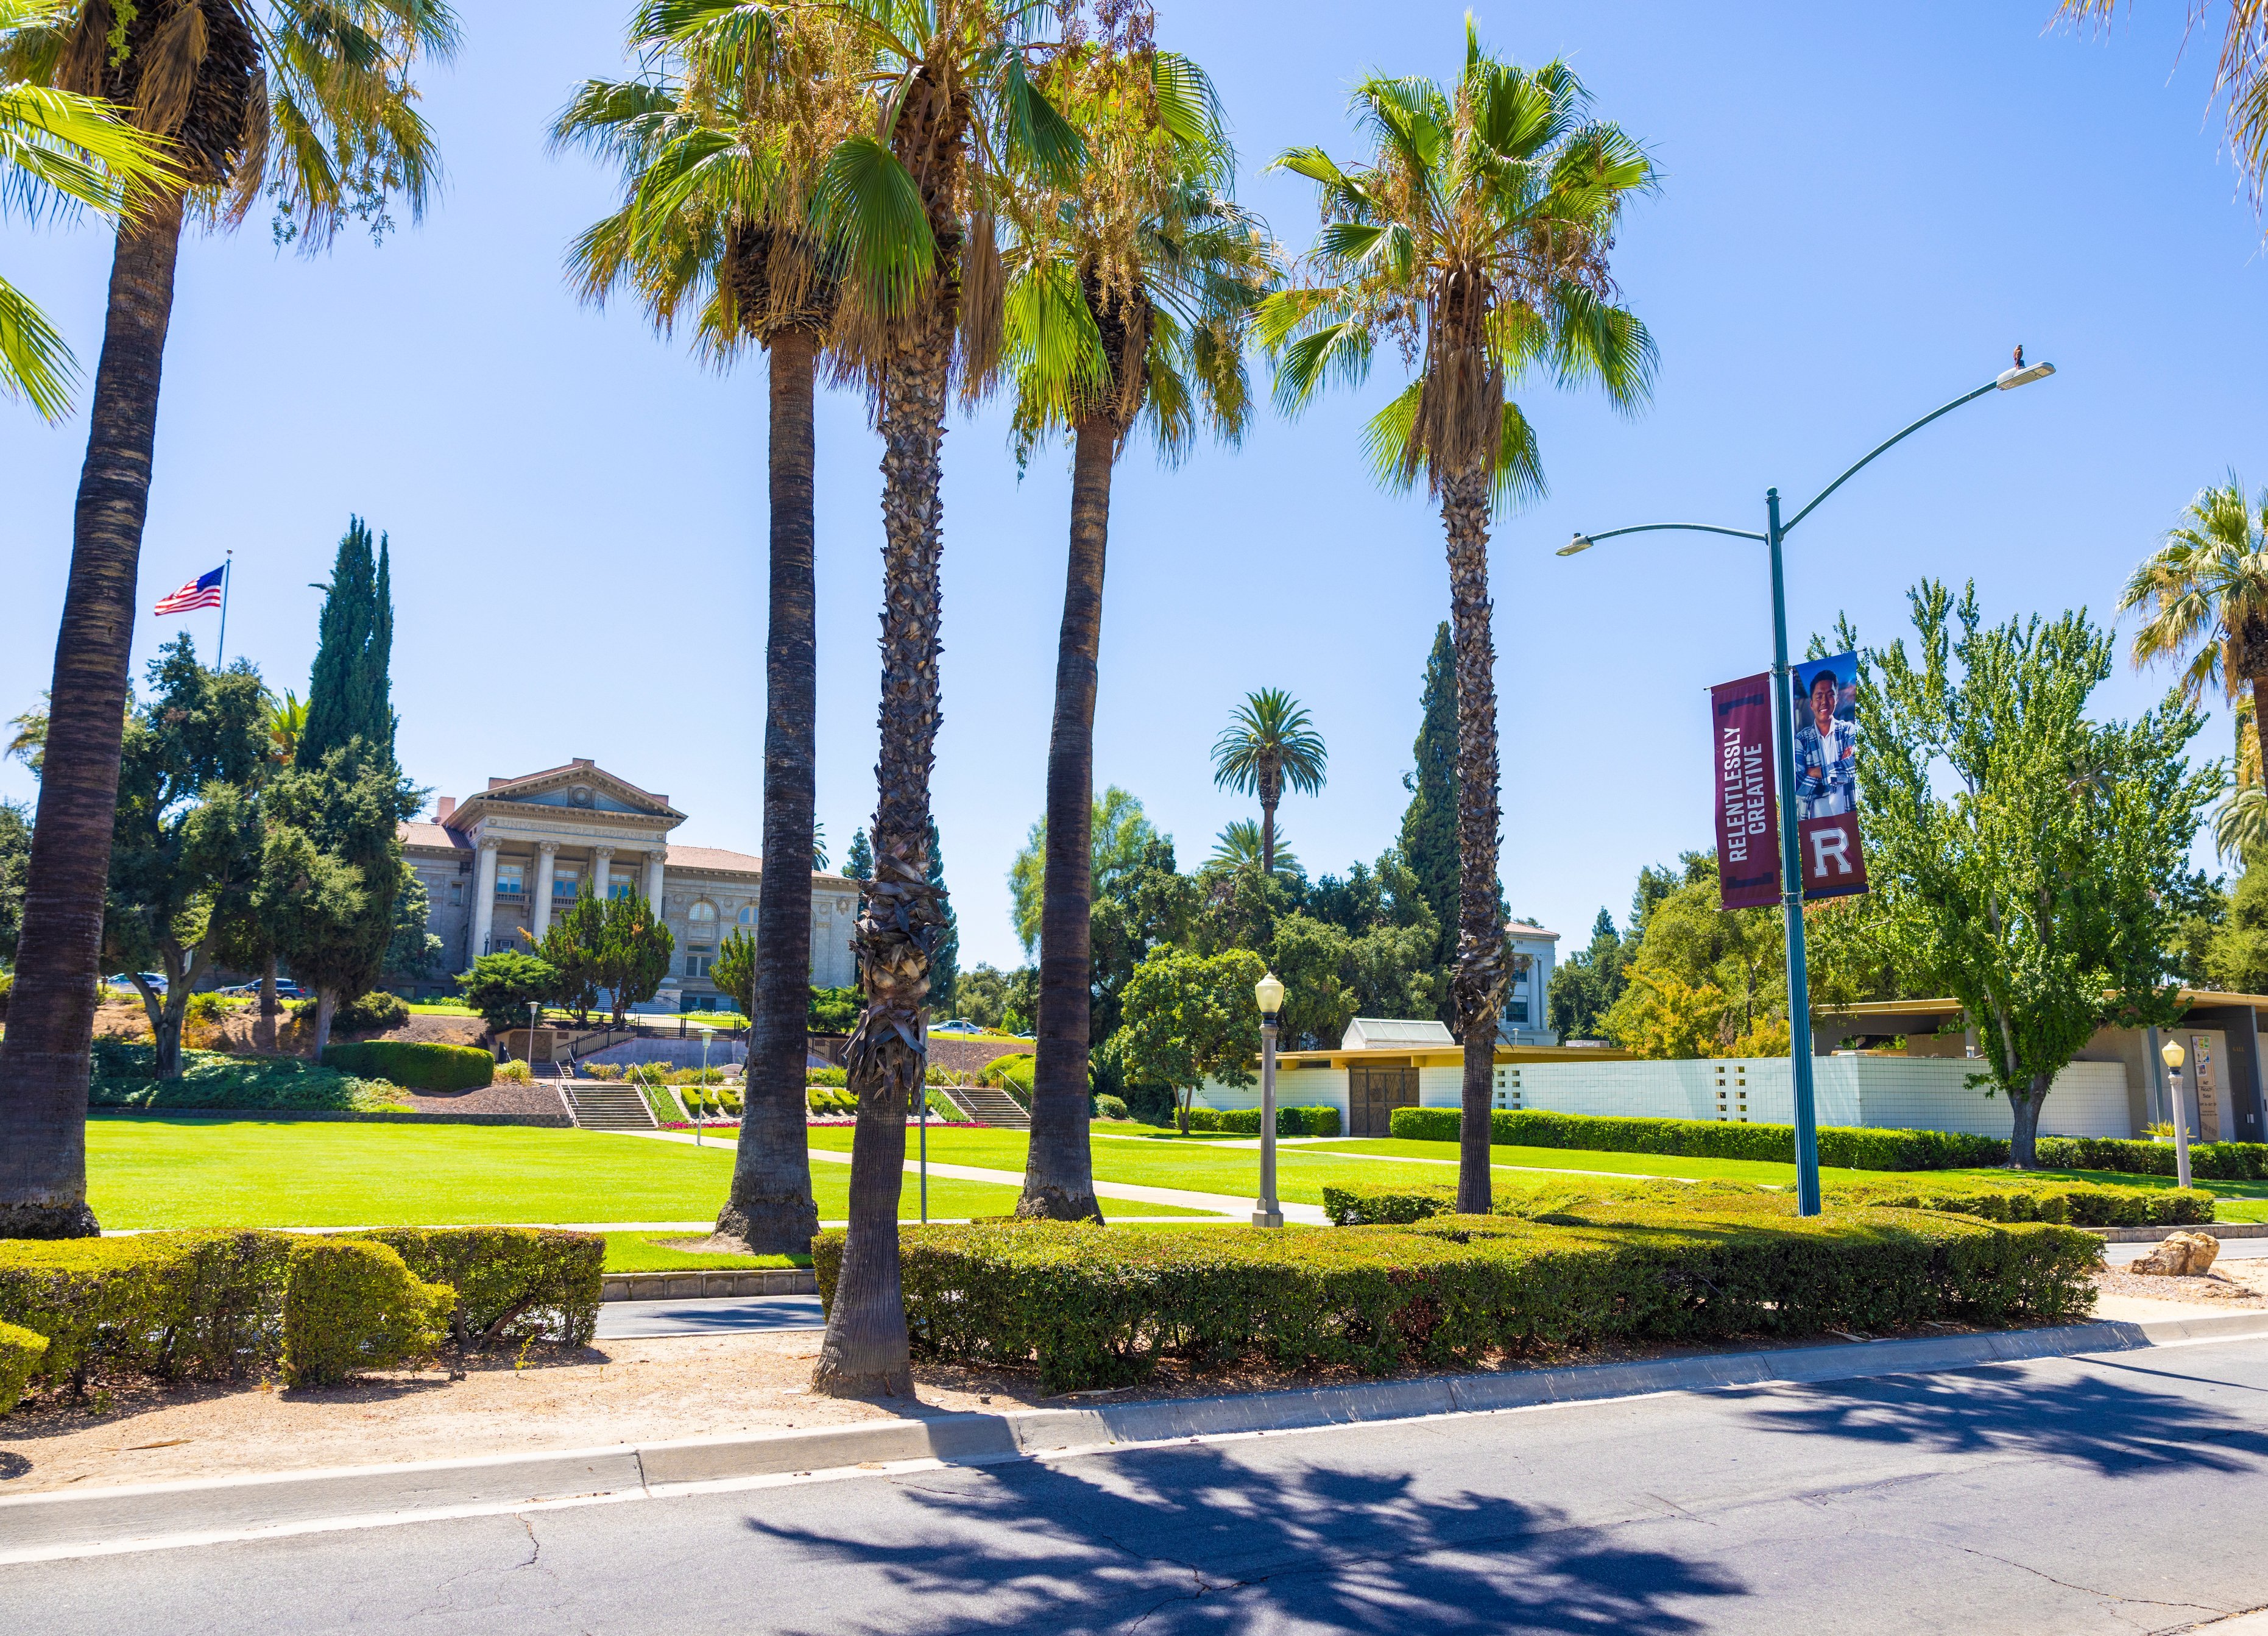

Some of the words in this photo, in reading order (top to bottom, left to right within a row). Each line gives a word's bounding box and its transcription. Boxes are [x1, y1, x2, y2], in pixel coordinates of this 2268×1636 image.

[1724, 728, 1747, 862] RELENTLESSLY
[1743, 743, 1766, 835] CREATIVE
[503, 821, 570, 832] UNIVERSITY
[594, 829, 651, 840] REDLANDS
[1810, 827, 1853, 878] R
